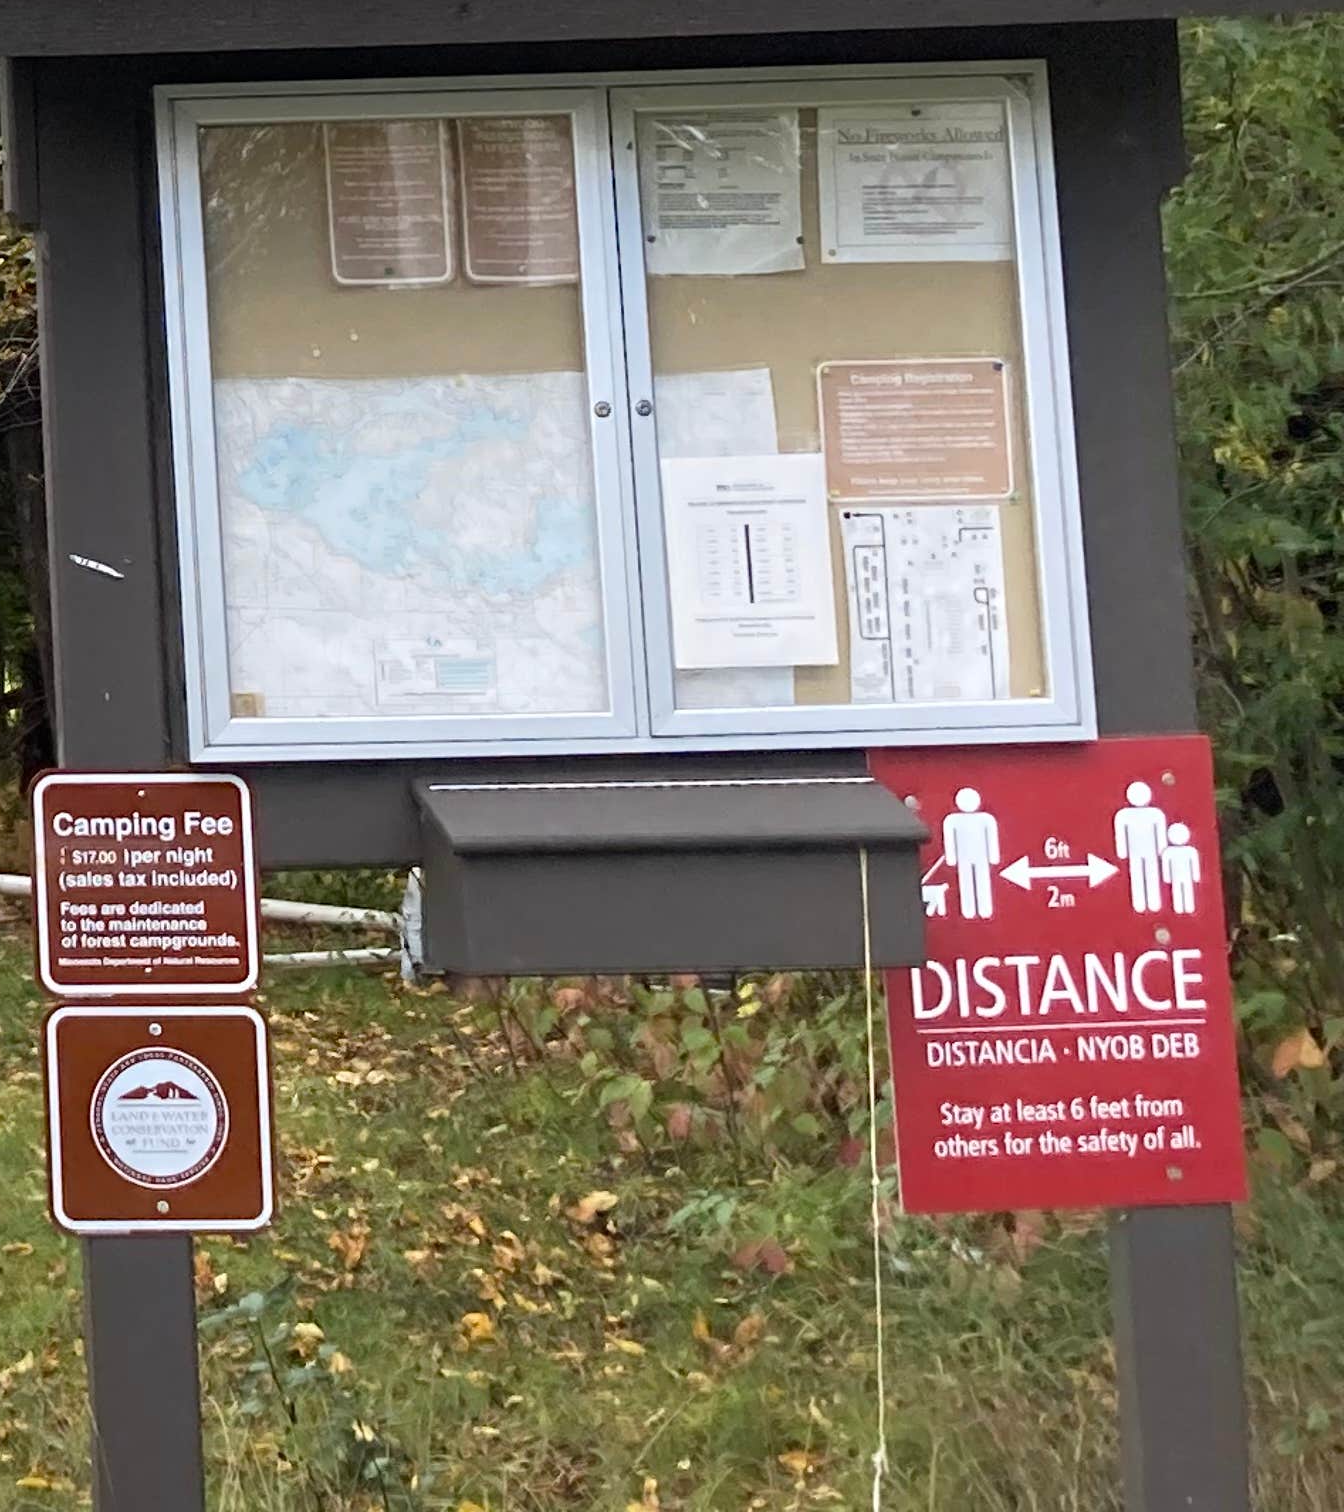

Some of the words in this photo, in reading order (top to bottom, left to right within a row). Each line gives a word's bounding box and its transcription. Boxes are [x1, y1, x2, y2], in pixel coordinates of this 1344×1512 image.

[53, 812, 175, 841] Camping
[184, 812, 233, 835] Fee
[72, 848, 117, 865] $17.00
[167, 846, 212, 867] night
[1044, 836, 1070, 860] 6ft
[59, 871, 113, 890] (sales
[119, 872, 146, 887] tax
[152, 870, 237, 890] included)
[1047, 885, 1076, 908] 2m
[61, 902, 96, 916] Fees
[101, 904, 125, 915] are
[130, 901, 205, 915] dedicated
[61, 919, 76, 931] to
[81, 918, 104, 931] the
[109, 918, 207, 931] maintenance
[62, 935, 77, 948] of
[81, 935, 126, 948] forest
[130, 933, 241, 951] campgrounds.
[911, 948, 1207, 1020] DISTANCE
[927, 1038, 1056, 1068] DISTANCIA
[1078, 1035, 1144, 1062] NYOB
[1152, 1032, 1199, 1059] DEB
[111, 1111, 148, 1121] LAND
[162, 1111, 208, 1121] WATER
[940, 1102, 984, 1130] Stay
[990, 1103, 1011, 1123] at
[1017, 1099, 1066, 1122] least
[1070, 1097, 1082, 1121] 6
[1090, 1095, 1130, 1120] feet
[1134, 1094, 1183, 1117] from
[112, 1124, 208, 1136] CONSERVATION
[934, 1132, 999, 1158] others
[1005, 1130, 1033, 1156] for
[1039, 1128, 1071, 1154] the
[1077, 1128, 1140, 1157] safety
[1144, 1126, 1166, 1151] of
[1171, 1125, 1201, 1150] all.
